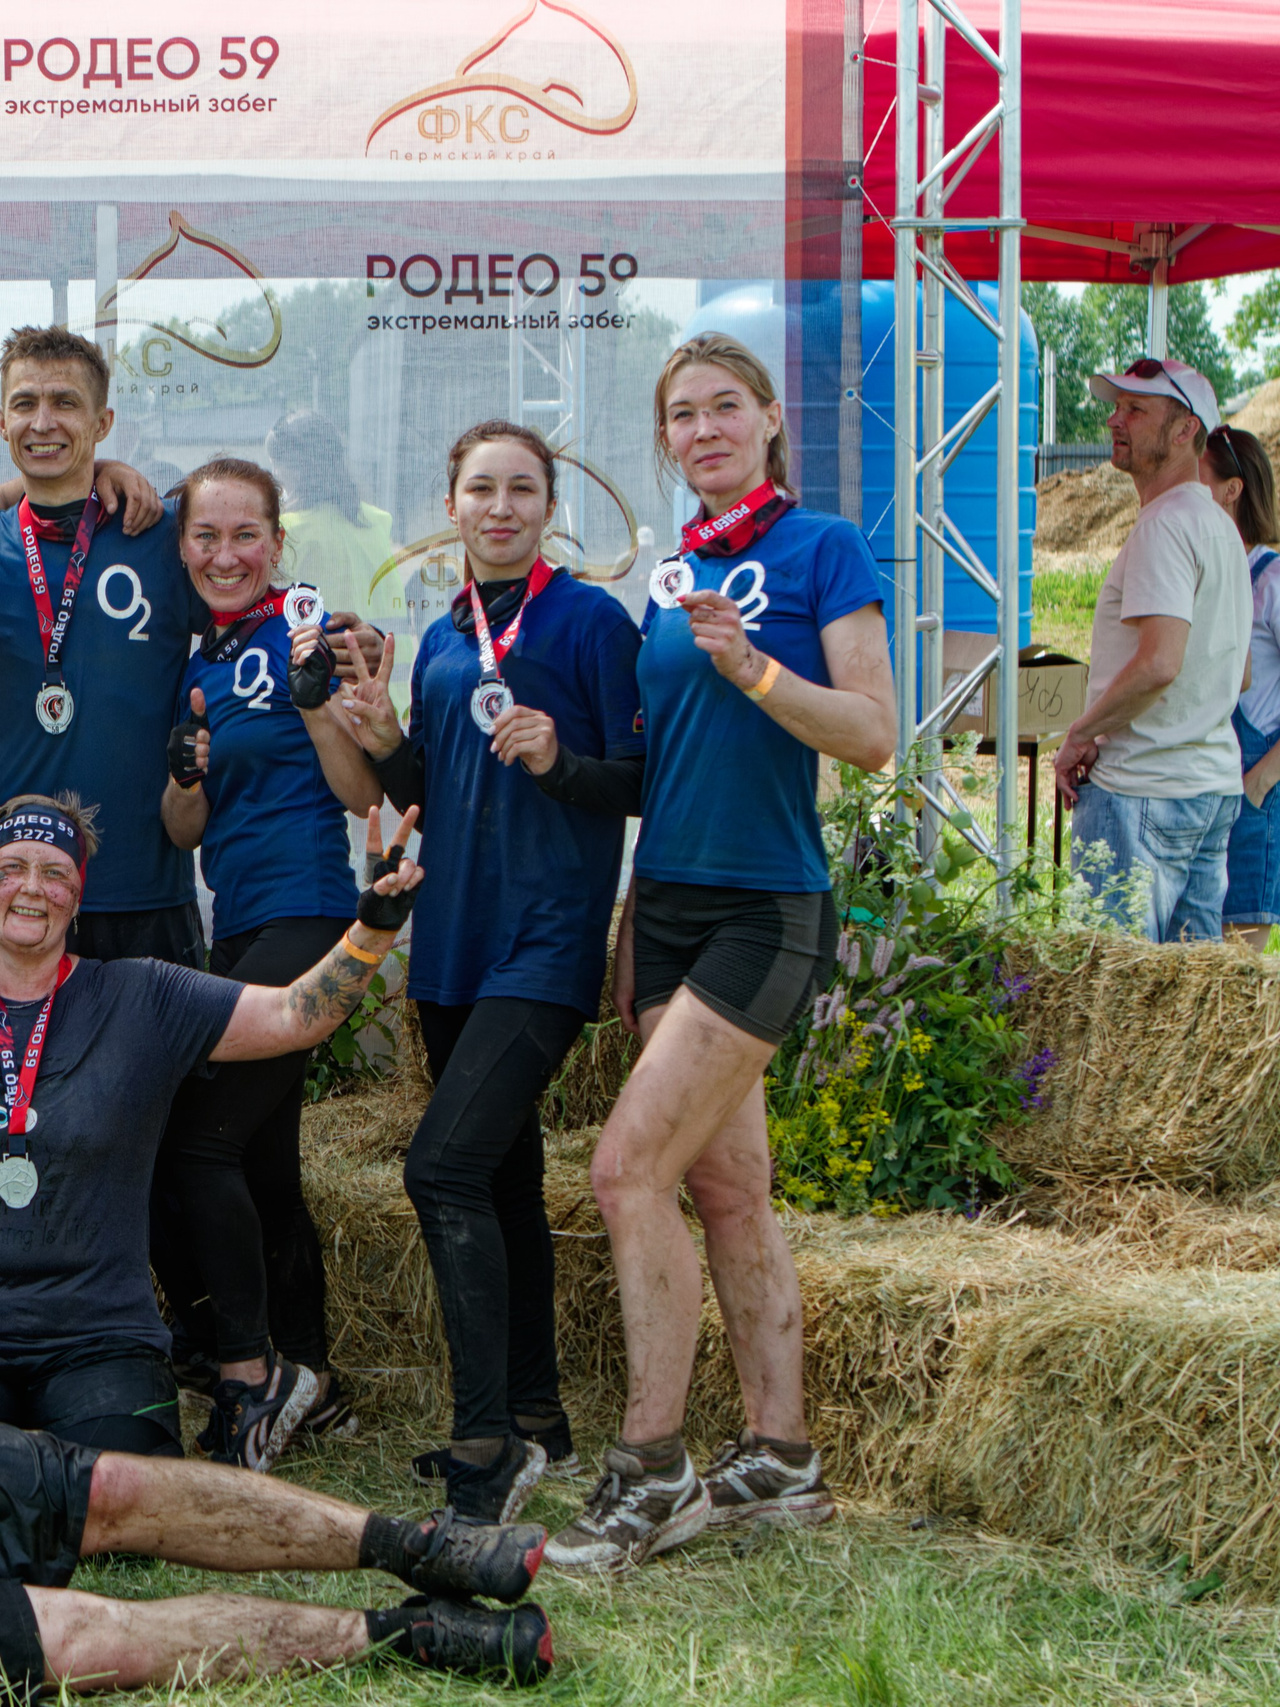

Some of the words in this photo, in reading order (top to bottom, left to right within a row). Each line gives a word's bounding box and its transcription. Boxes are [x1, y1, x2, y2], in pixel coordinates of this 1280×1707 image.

[3, 36, 201, 89] РОДЕО
[218, 35, 280, 80] 59
[4, 94, 200, 119] экстремальный
[208, 93, 278, 113] забег
[417, 104, 530, 144] ФКС
[389, 149, 497, 163] Пермский
[505, 149, 556, 162] край
[366, 253, 560, 305] РОДЕО
[578, 252, 638, 297] 59
[367, 311, 560, 334] экстремальный
[567, 310, 636, 330] забег
[107, 337, 174, 378] КС
[148, 382, 200, 397] край
[712, 502, 751, 532] РОДЕО
[698, 525, 716, 541] 59
[23, 525, 42, 575] РОДЕО
[32, 575, 46, 596] 59
[263, 602, 275, 616] 59
[48, 609, 72, 664] РОДЕО
[61, 587, 75, 608] 59
[13, 829, 55, 843] 3272
[58, 821, 74, 838] 59
[31, 997, 53, 1045] ОДЕО
[1, 1050, 15, 1069] 59
[25, 1048, 39, 1068] 59
